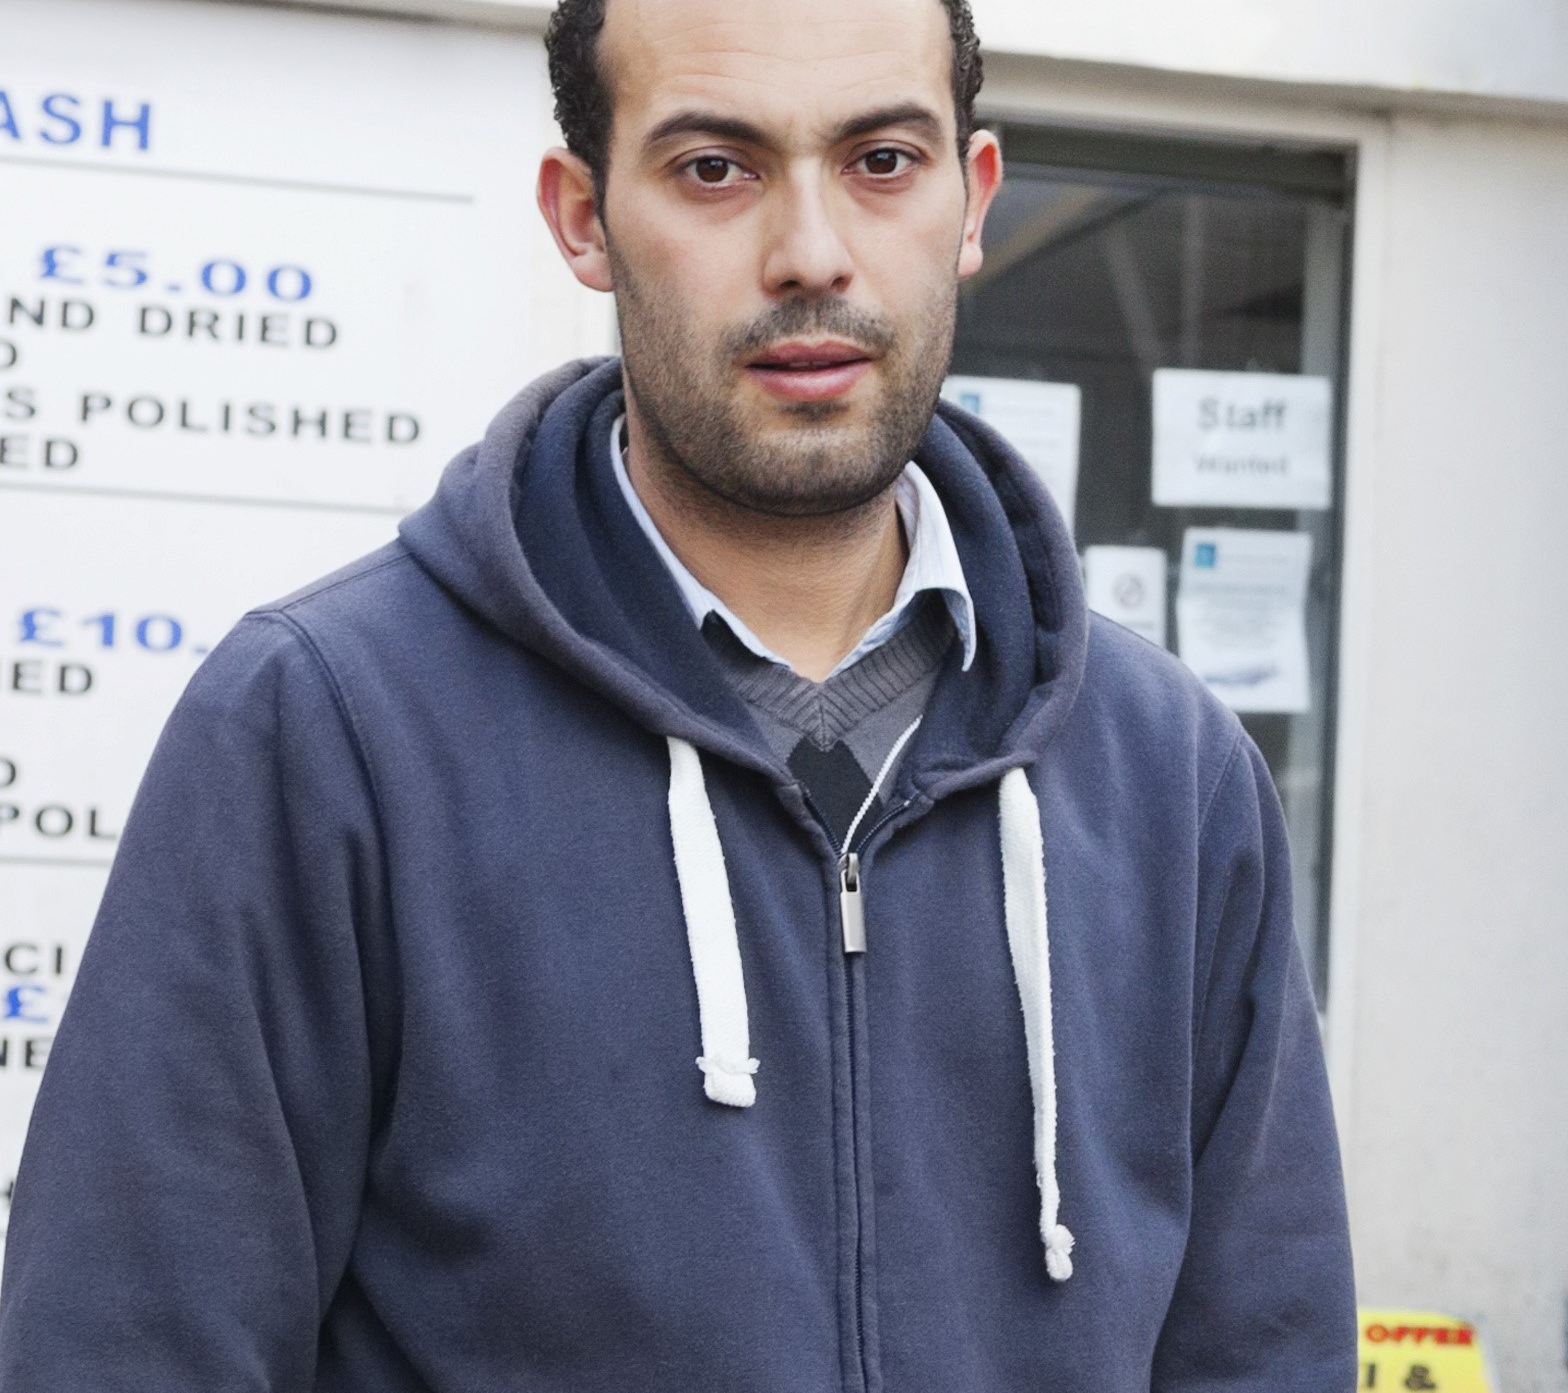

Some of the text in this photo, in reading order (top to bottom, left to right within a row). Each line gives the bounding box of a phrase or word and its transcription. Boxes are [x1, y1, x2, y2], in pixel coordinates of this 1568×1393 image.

[41, 247, 312, 300] £5.00
[139, 306, 337, 347] DRIED
[81, 394, 420, 443] POLISHED
